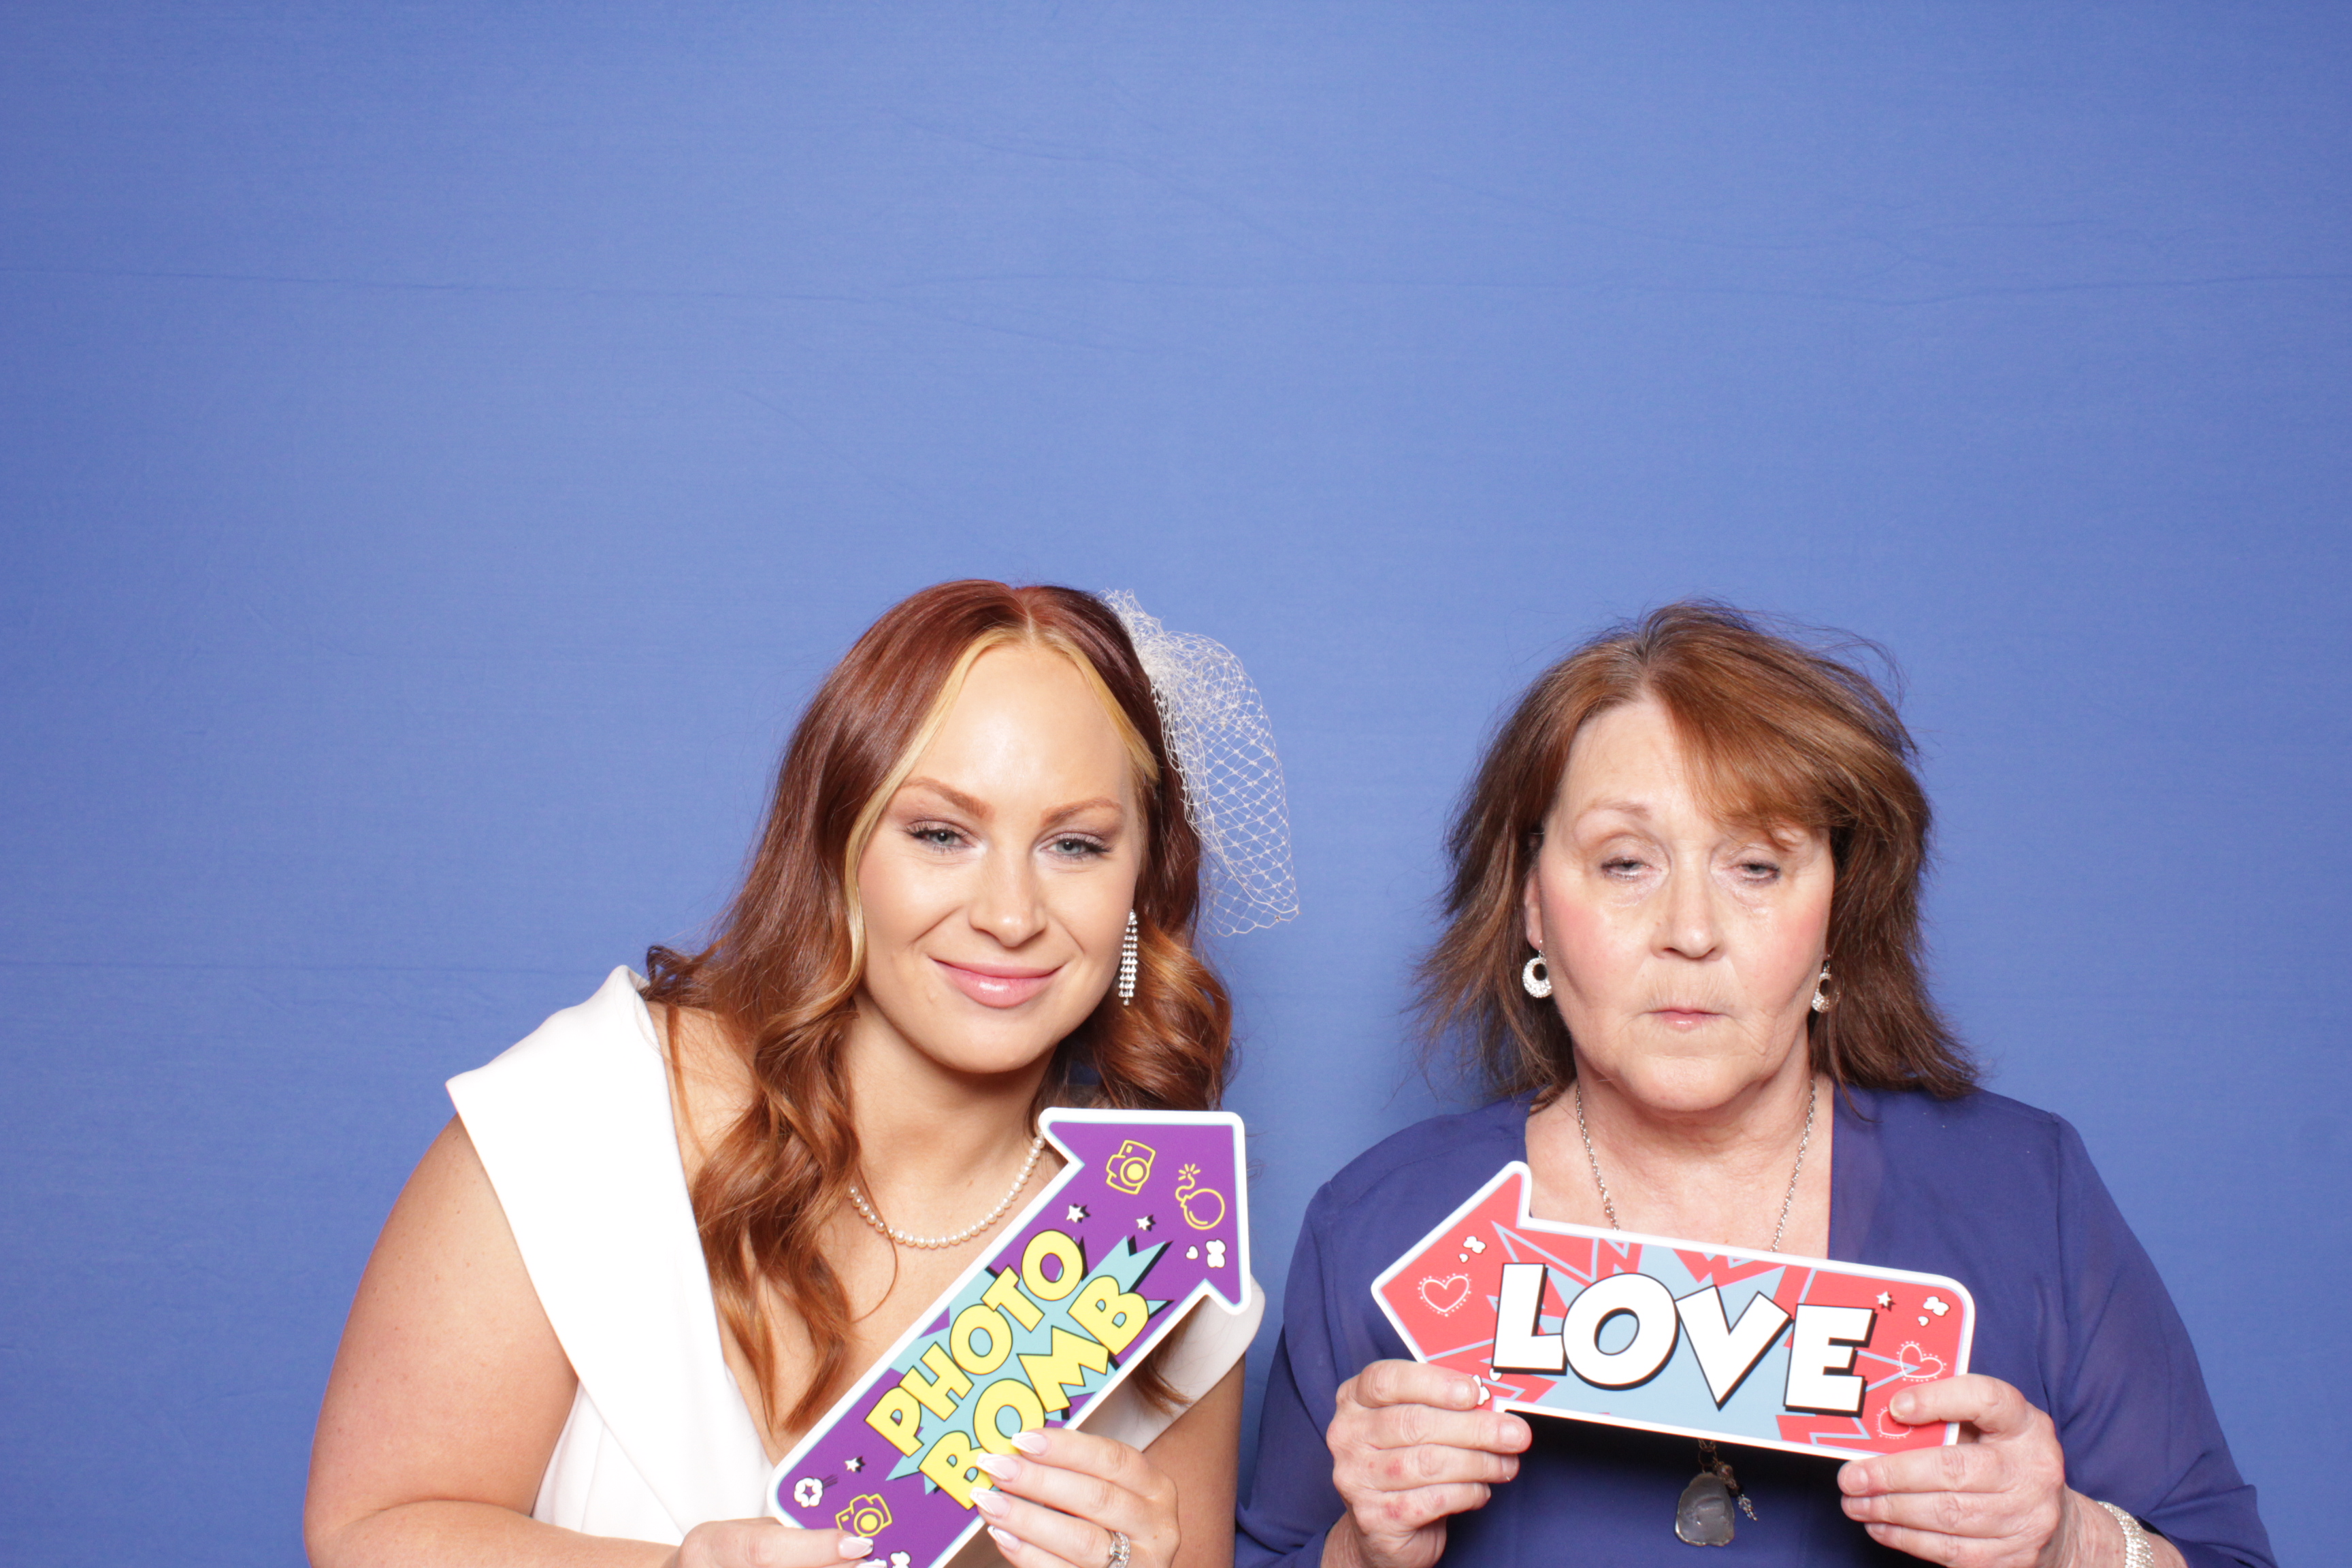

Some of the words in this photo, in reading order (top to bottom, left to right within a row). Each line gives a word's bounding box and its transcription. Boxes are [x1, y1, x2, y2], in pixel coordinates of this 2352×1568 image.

[864, 1229, 1083, 1458] PHOTO
[918, 1275, 1149, 1510] BOMB
[1492, 1262, 1876, 1417] LOVE
